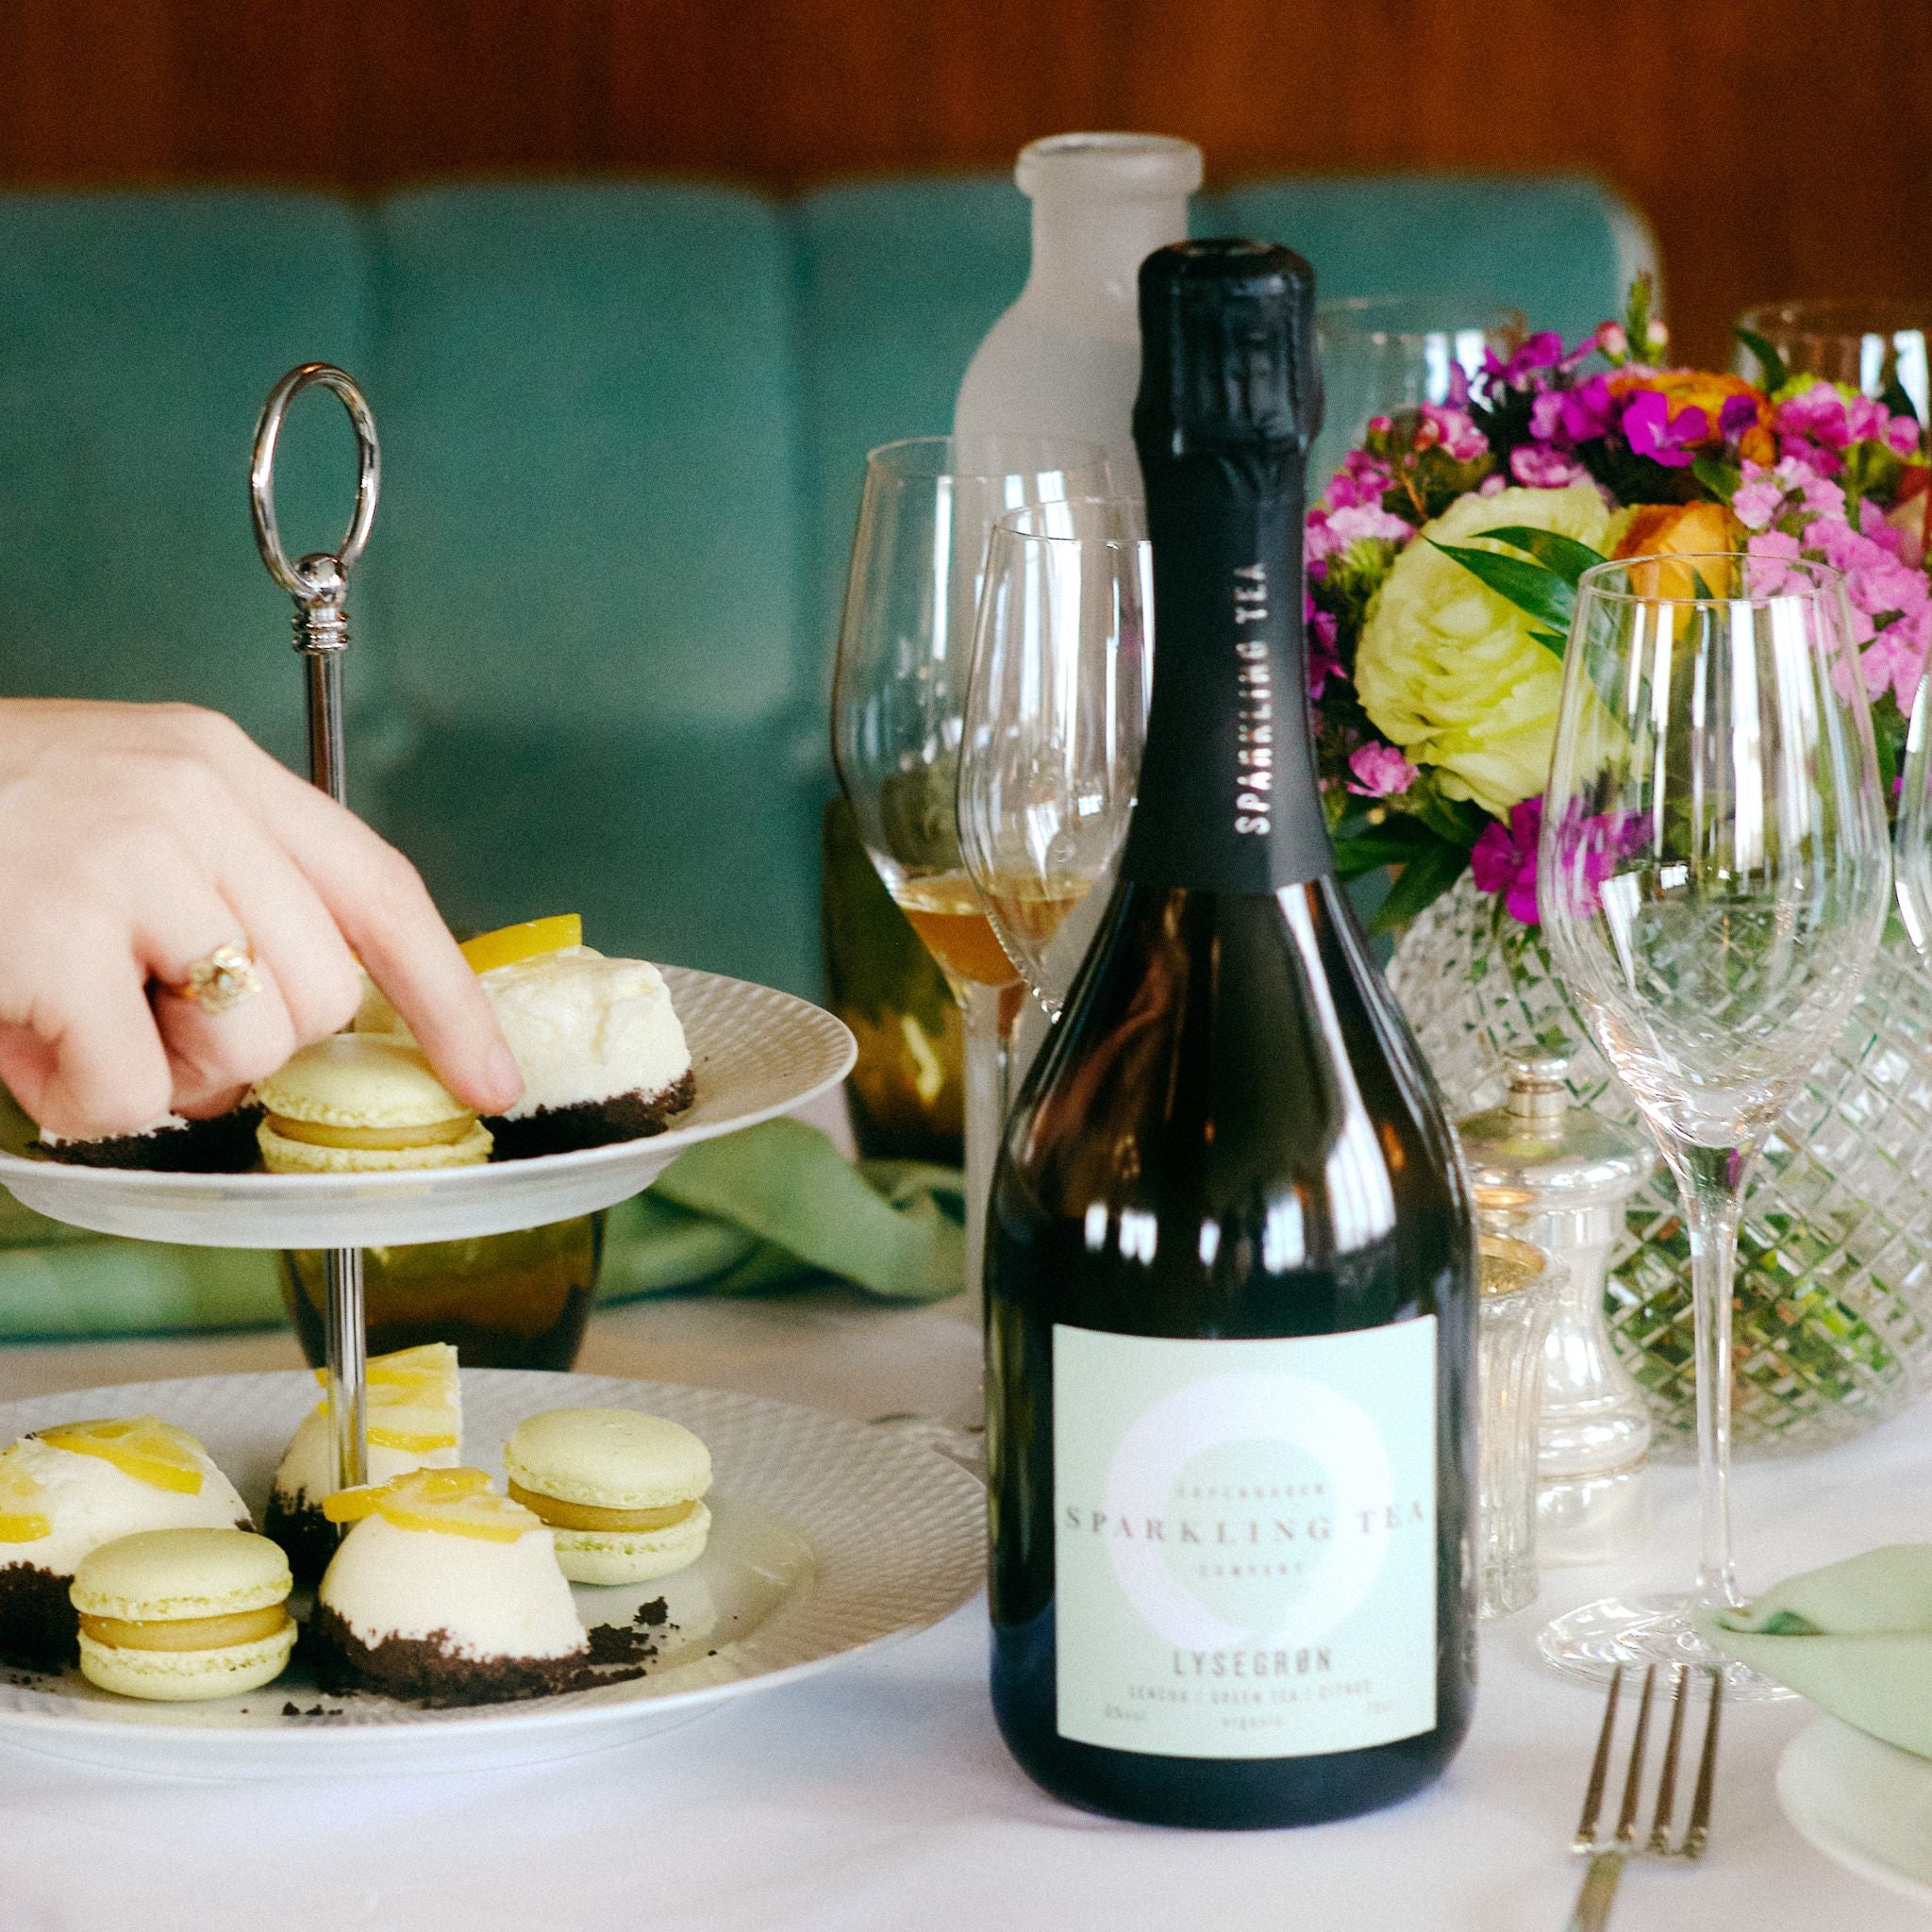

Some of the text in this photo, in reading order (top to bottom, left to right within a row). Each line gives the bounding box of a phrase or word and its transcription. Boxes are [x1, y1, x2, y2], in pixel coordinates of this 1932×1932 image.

[1233, 563, 1272, 835] SPARKLING TEA
[1064, 1500, 1424, 1546] SPARKLING TEA
[1172, 1646, 1333, 1677] LYSEGRØN
